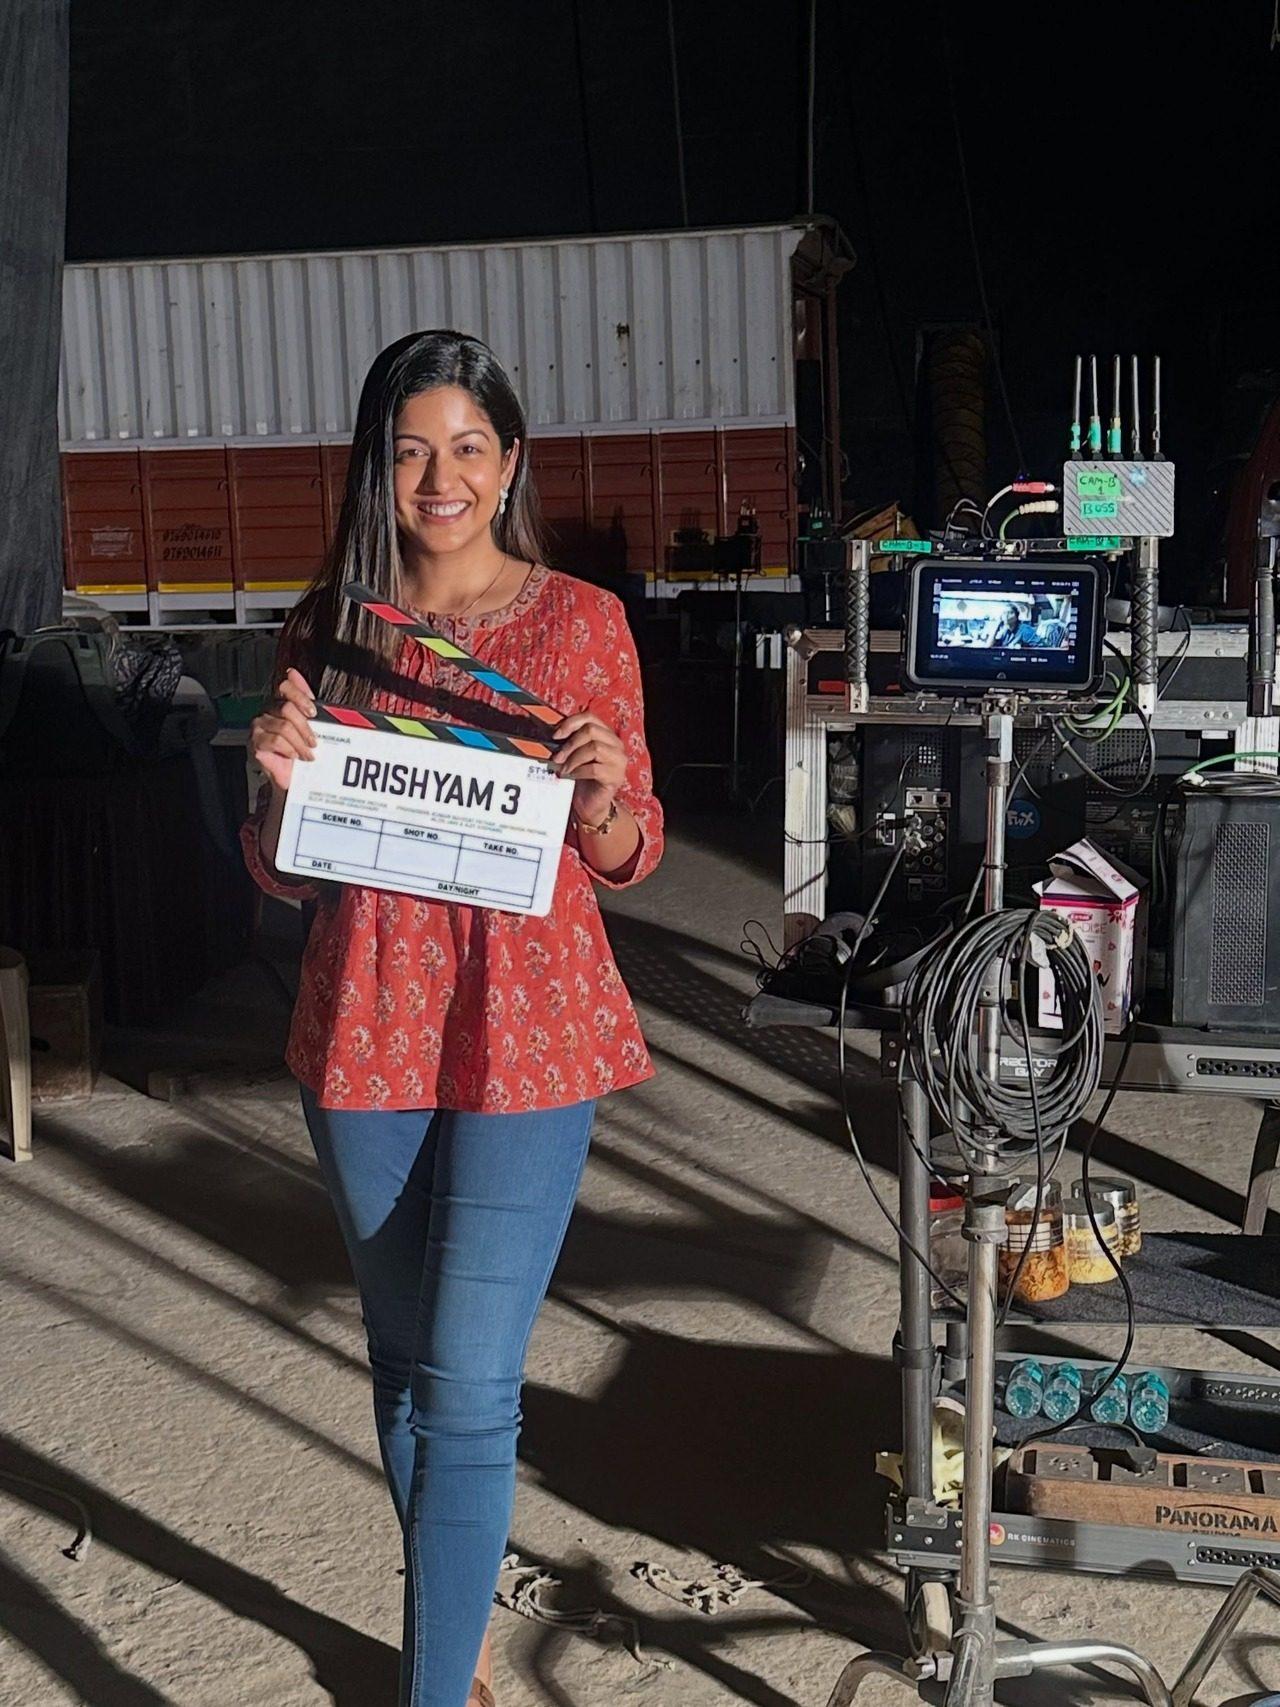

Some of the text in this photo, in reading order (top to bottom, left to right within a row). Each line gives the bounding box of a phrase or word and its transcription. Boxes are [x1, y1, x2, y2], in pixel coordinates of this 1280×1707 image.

[342, 755, 495, 811] DRISHYAM
[501, 783, 521, 816] 3
[322, 812, 348, 824] SCENE
[403, 828, 425, 838] SHOT
[483, 842, 504, 853] TAKE
[1155, 1504, 1278, 1533] PANORAMA
[1021, 1534, 1076, 1547] CINEMATICS
